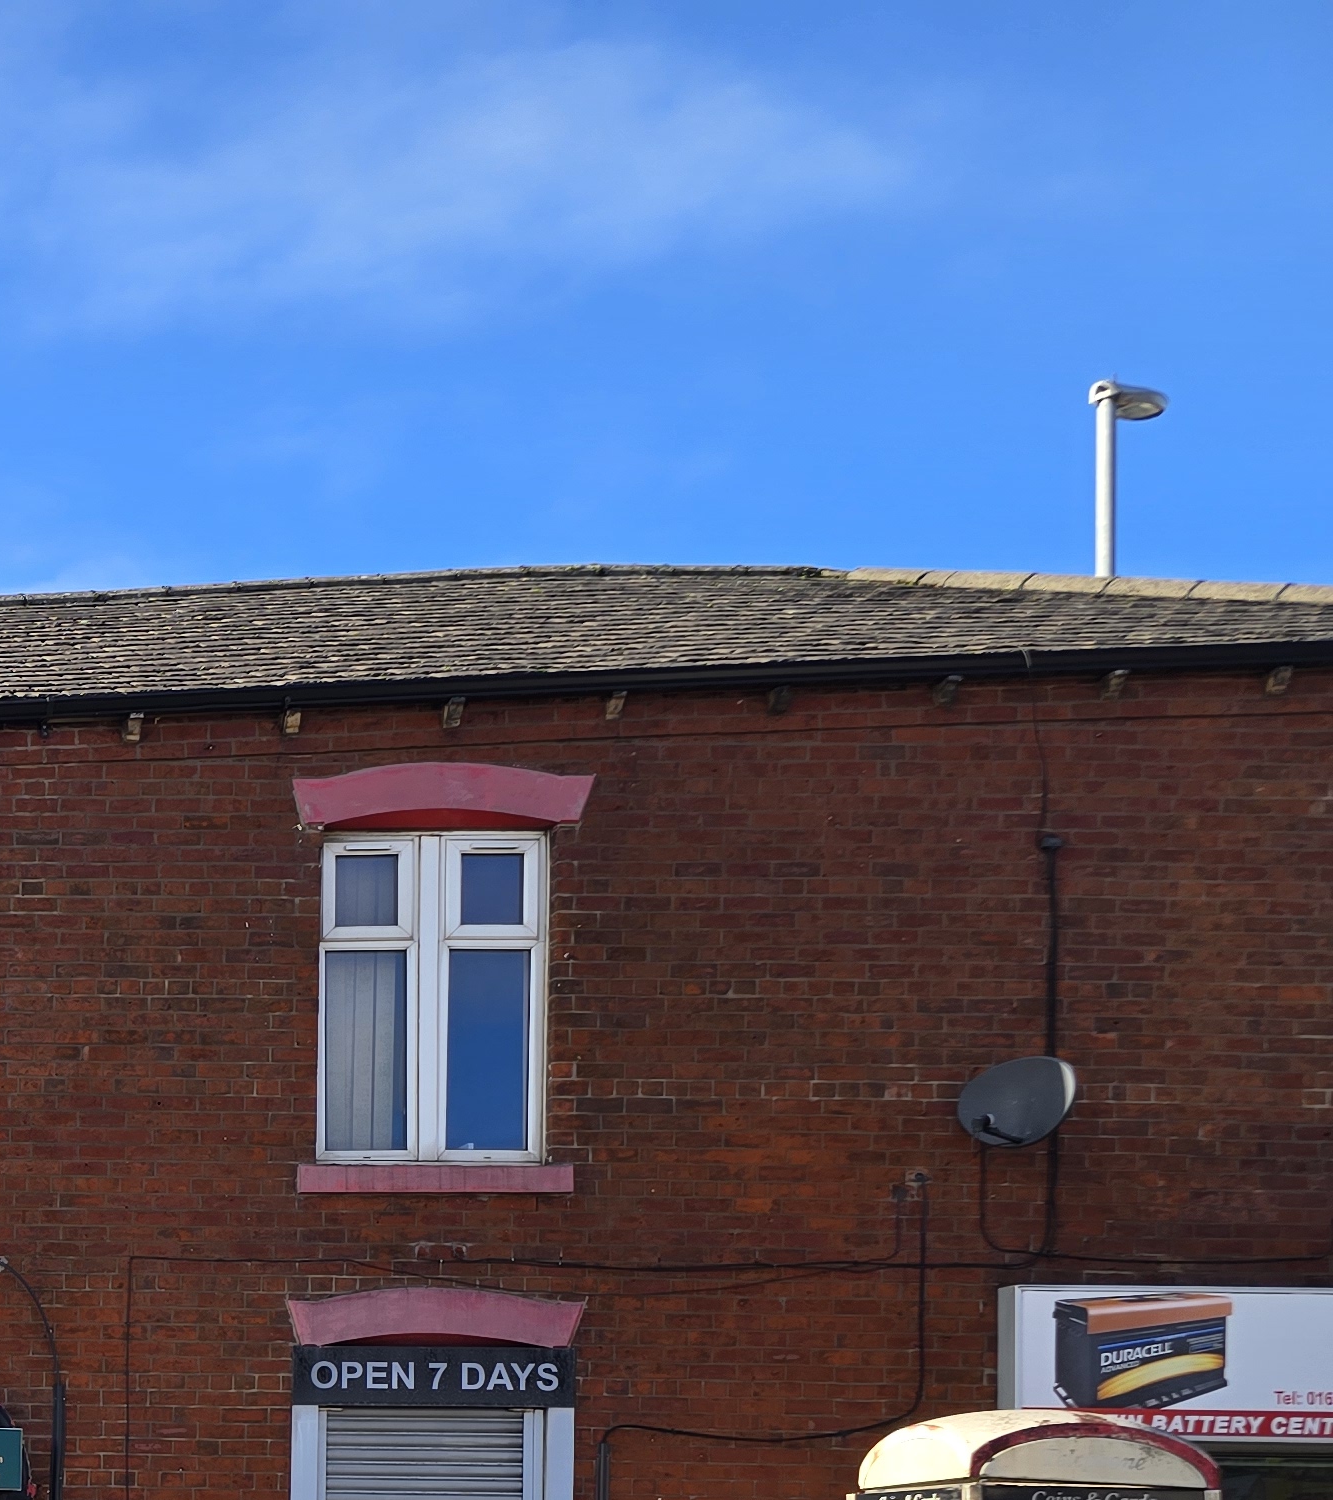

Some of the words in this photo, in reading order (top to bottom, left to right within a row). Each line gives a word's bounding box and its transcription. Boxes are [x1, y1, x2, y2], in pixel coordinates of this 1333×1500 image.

[1100, 1342, 1174, 1367] DURACELL
[310, 1360, 415, 1390] OPEN
[428, 1362, 448, 1390] 7
[461, 1362, 560, 1392] DAYS
[1274, 1391, 1303, 1405] Tel:
[1152, 1415, 1265, 1434] BATTERY
